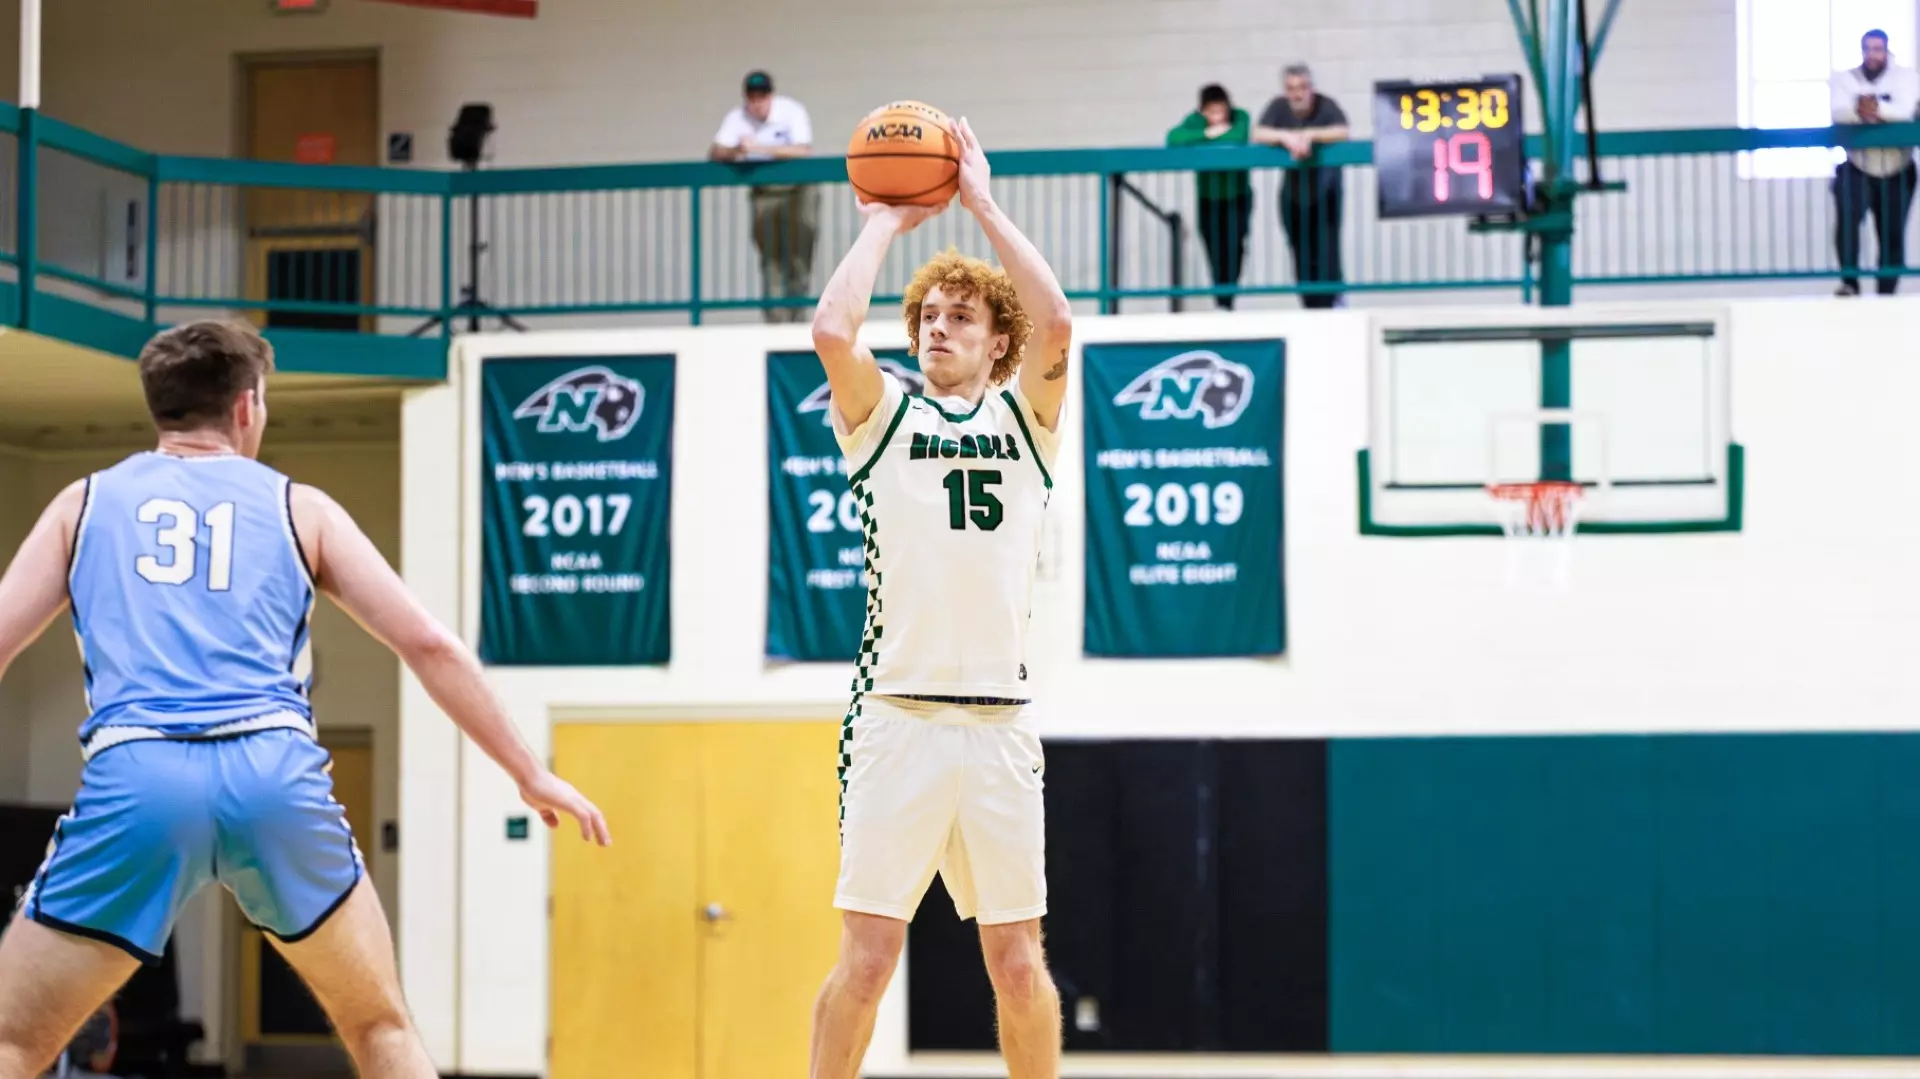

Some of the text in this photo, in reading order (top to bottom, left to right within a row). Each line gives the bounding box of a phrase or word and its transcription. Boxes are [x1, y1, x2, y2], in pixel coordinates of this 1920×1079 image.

[1400, 88, 1509, 132] 13:30
[866, 123, 923, 142] NCAA
[1433, 131, 1494, 202] 19
[910, 432, 1020, 461] NICHOLS
[1097, 447, 1271, 469] MEN'S BASKETBALL
[495, 460, 659, 481] MEN'S BASKETBALL
[806, 489, 863, 533] 20
[943, 469, 1003, 531] 15
[1123, 481, 1245, 527] 2019
[522, 494, 632, 537] 2017
[135, 497, 236, 592] 31
[1156, 541, 1212, 561] NCAA
[551, 553, 602, 570] NCAA
[1129, 563, 1237, 584] ELITE EIGHT
[510, 574, 645, 594] SECOND ROUND
